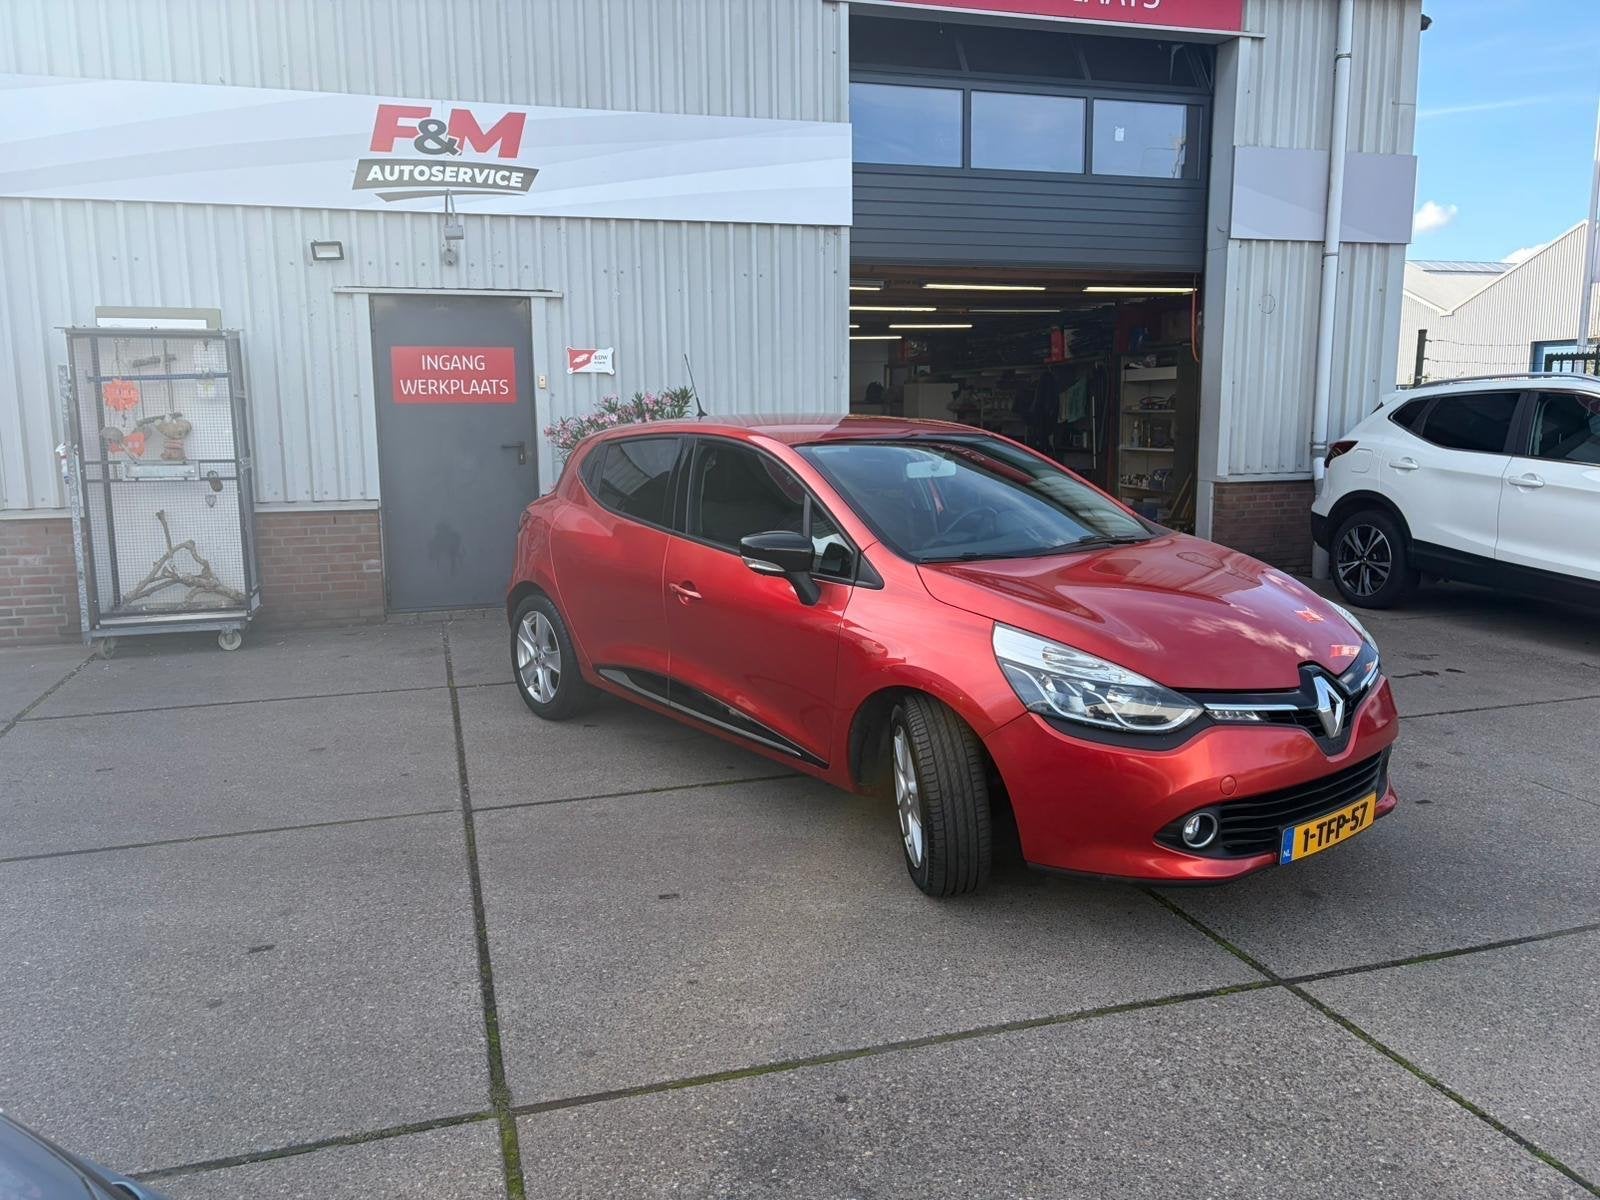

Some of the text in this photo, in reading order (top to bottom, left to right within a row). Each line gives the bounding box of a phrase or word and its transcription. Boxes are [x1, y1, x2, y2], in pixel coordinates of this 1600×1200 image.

[370, 104, 527, 158] F&M
[366, 165, 525, 188] AUTOSERVICE
[421, 354, 486, 371] INGANG
[399, 379, 509, 395] WERKPLAATS
[1303, 801, 1369, 852] 1-TFP-57
